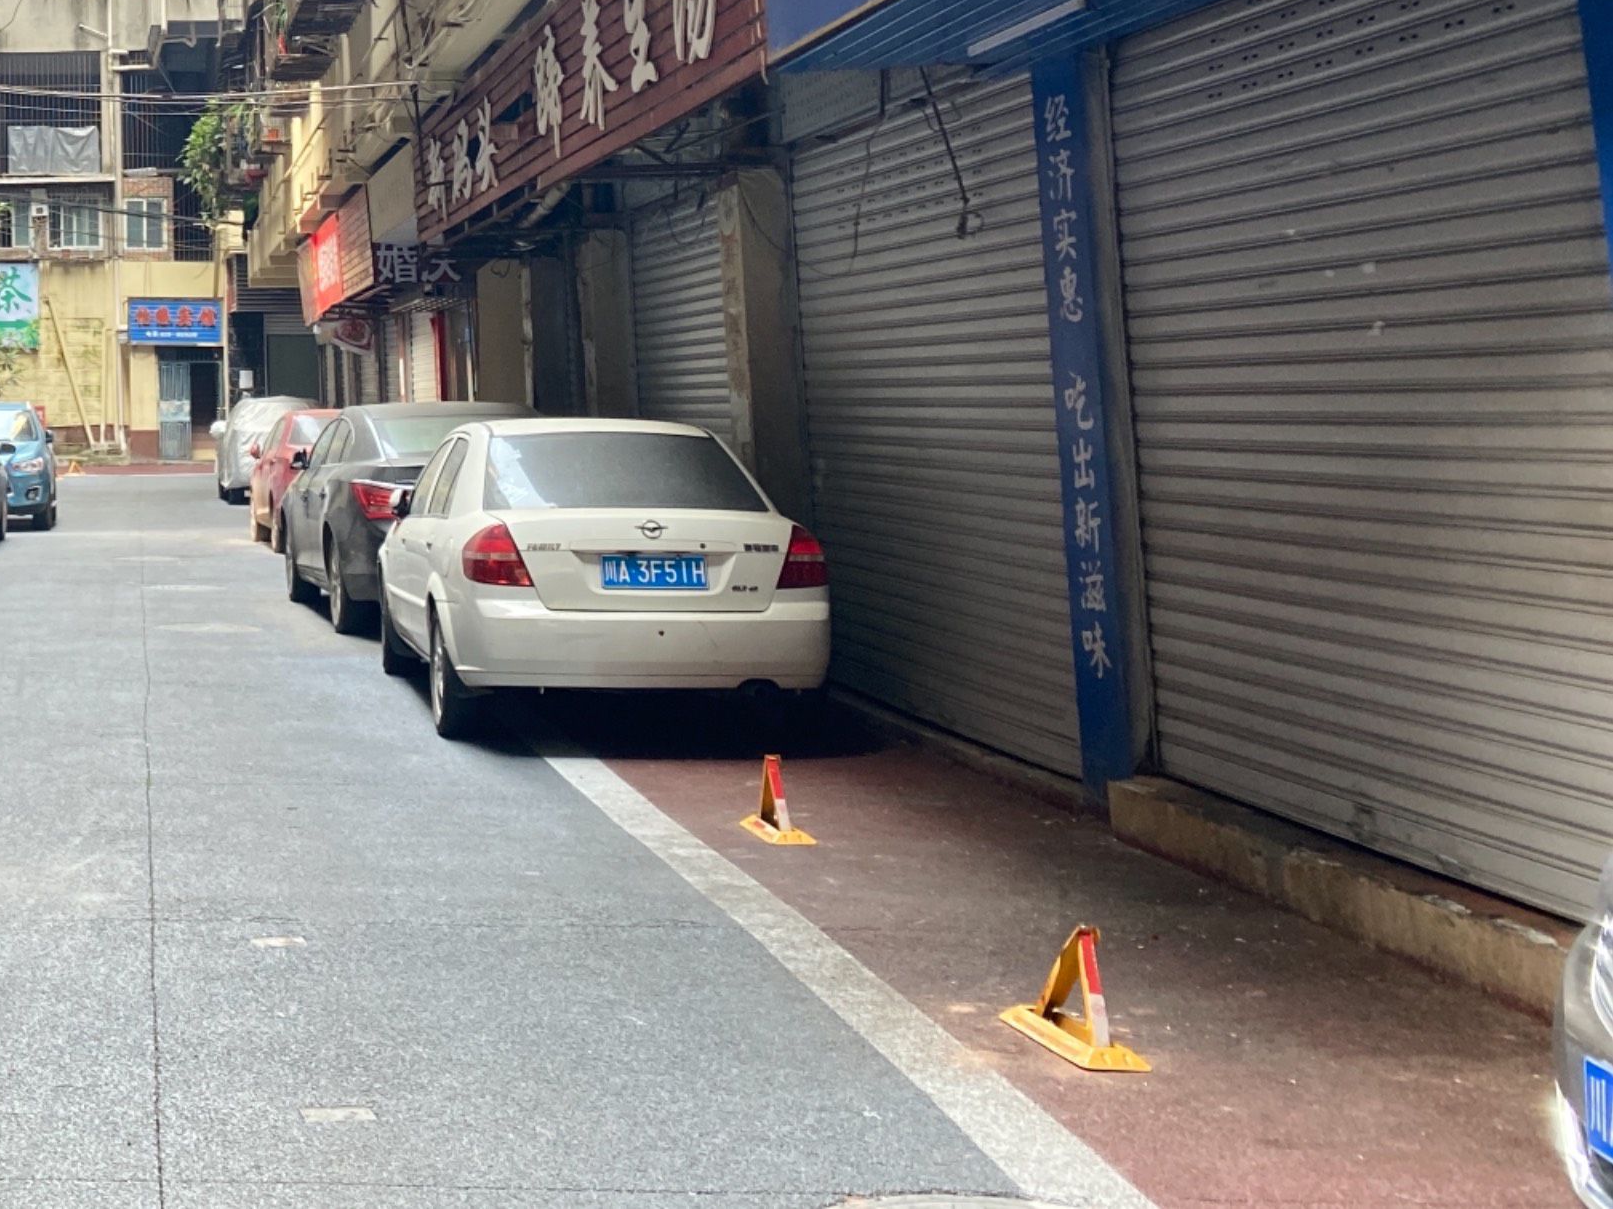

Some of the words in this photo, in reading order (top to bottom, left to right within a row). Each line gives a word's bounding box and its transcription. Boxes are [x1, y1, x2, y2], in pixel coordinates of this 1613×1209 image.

[1043, 93, 1084, 323] 经济实惠
[1063, 370, 1113, 680] 吃出新滋味
